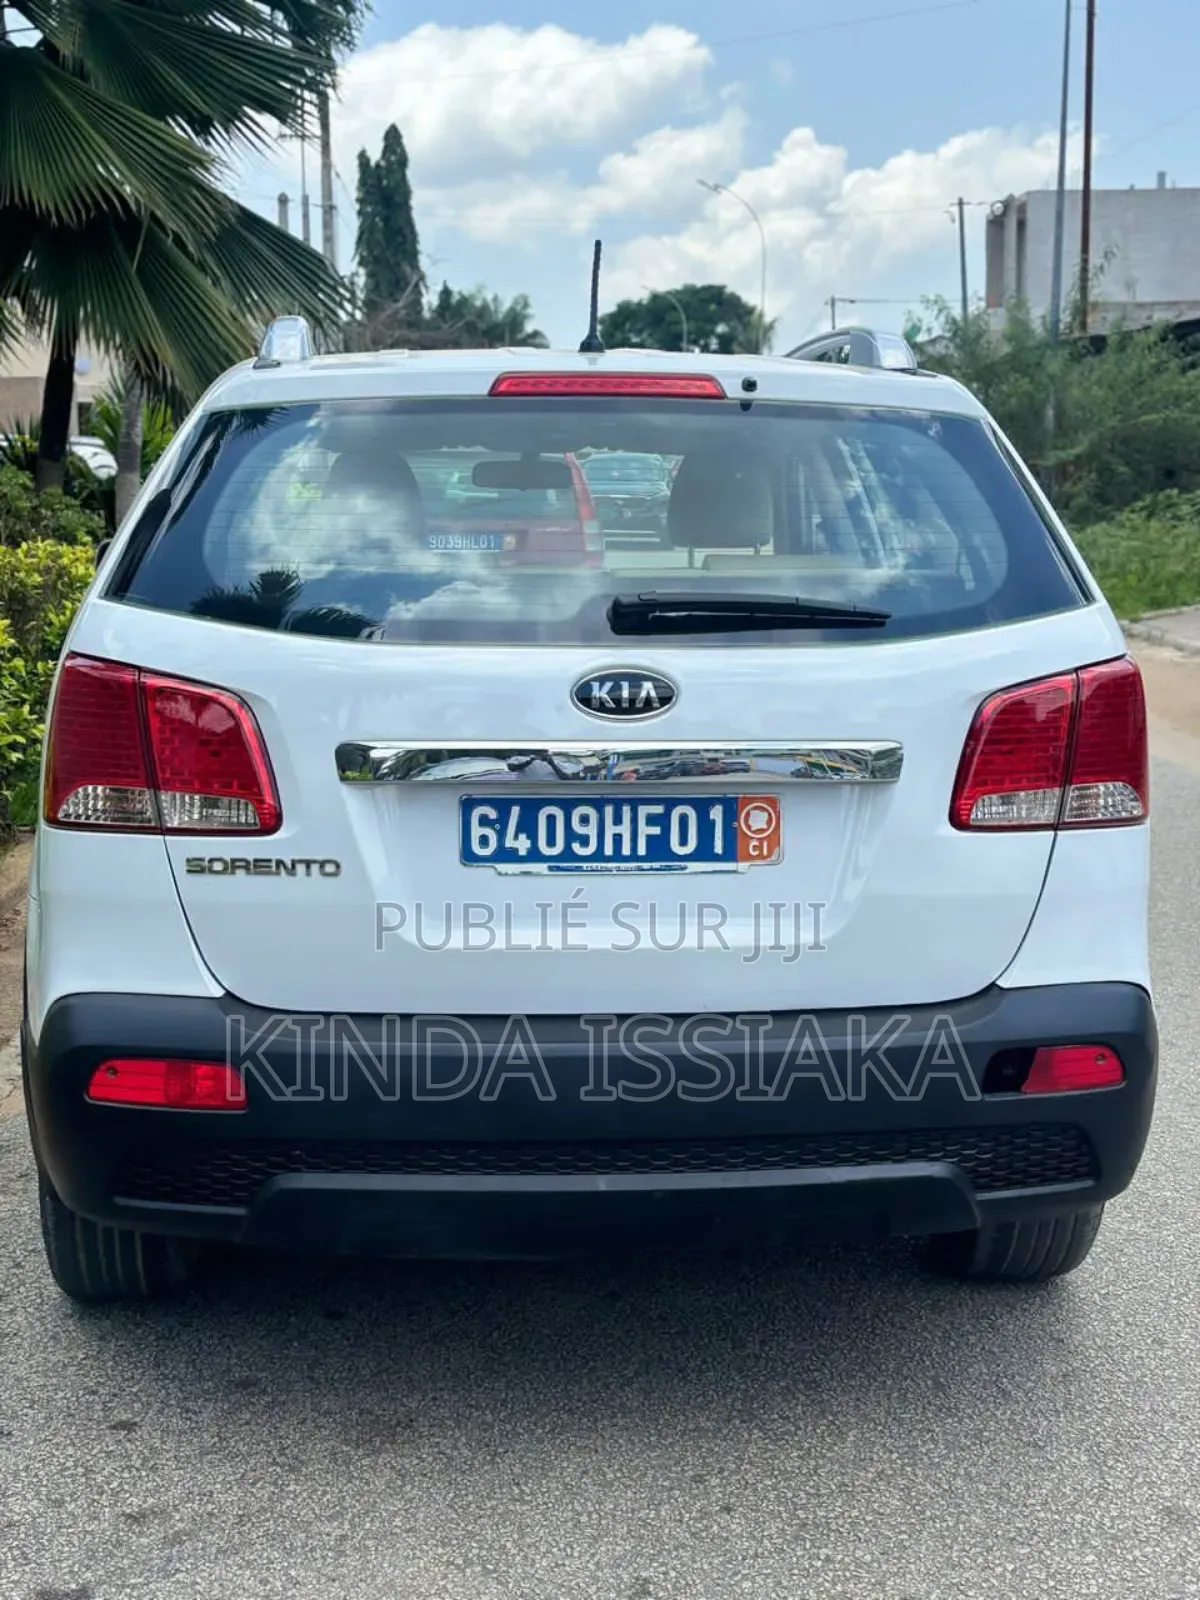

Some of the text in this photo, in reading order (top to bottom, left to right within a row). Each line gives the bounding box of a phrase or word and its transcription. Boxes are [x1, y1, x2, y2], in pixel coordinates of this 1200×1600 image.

[589, 680, 661, 709] KIA
[470, 803, 724, 857] 6409HF01
[748, 840, 769, 857] CI
[185, 857, 341, 877] SORENTO
